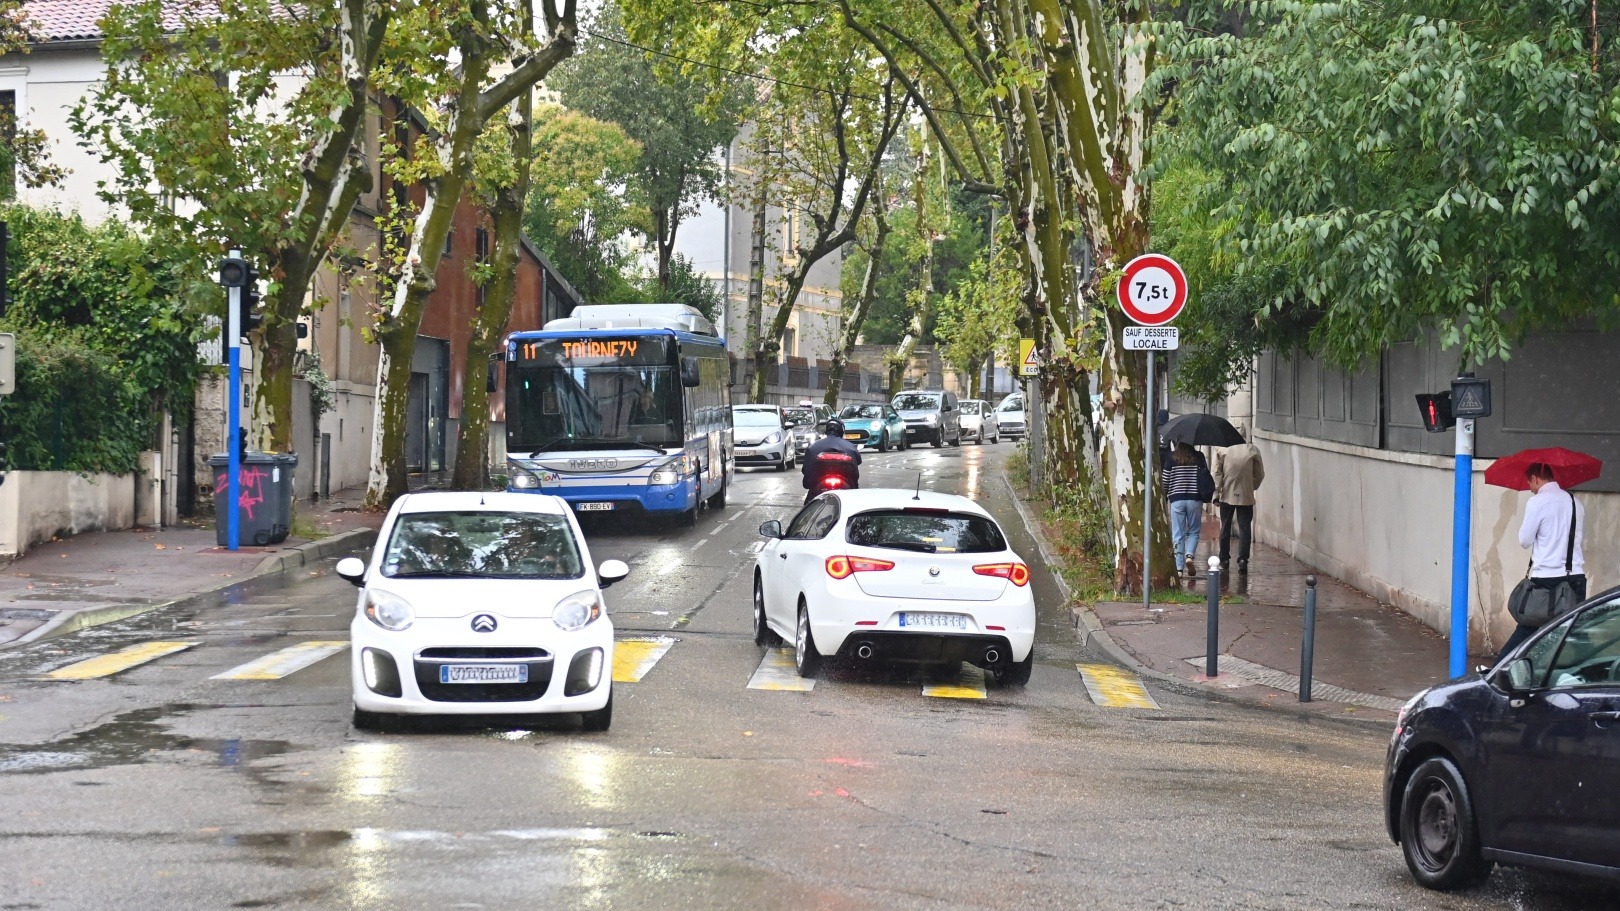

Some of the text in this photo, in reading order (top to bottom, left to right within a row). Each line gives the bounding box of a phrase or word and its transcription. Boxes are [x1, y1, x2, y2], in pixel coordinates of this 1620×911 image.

[1125, 327, 1177, 338] SAUF DESSERTE
[1133, 339, 1168, 349] LOCALE
[523, 343, 537, 360] 11
